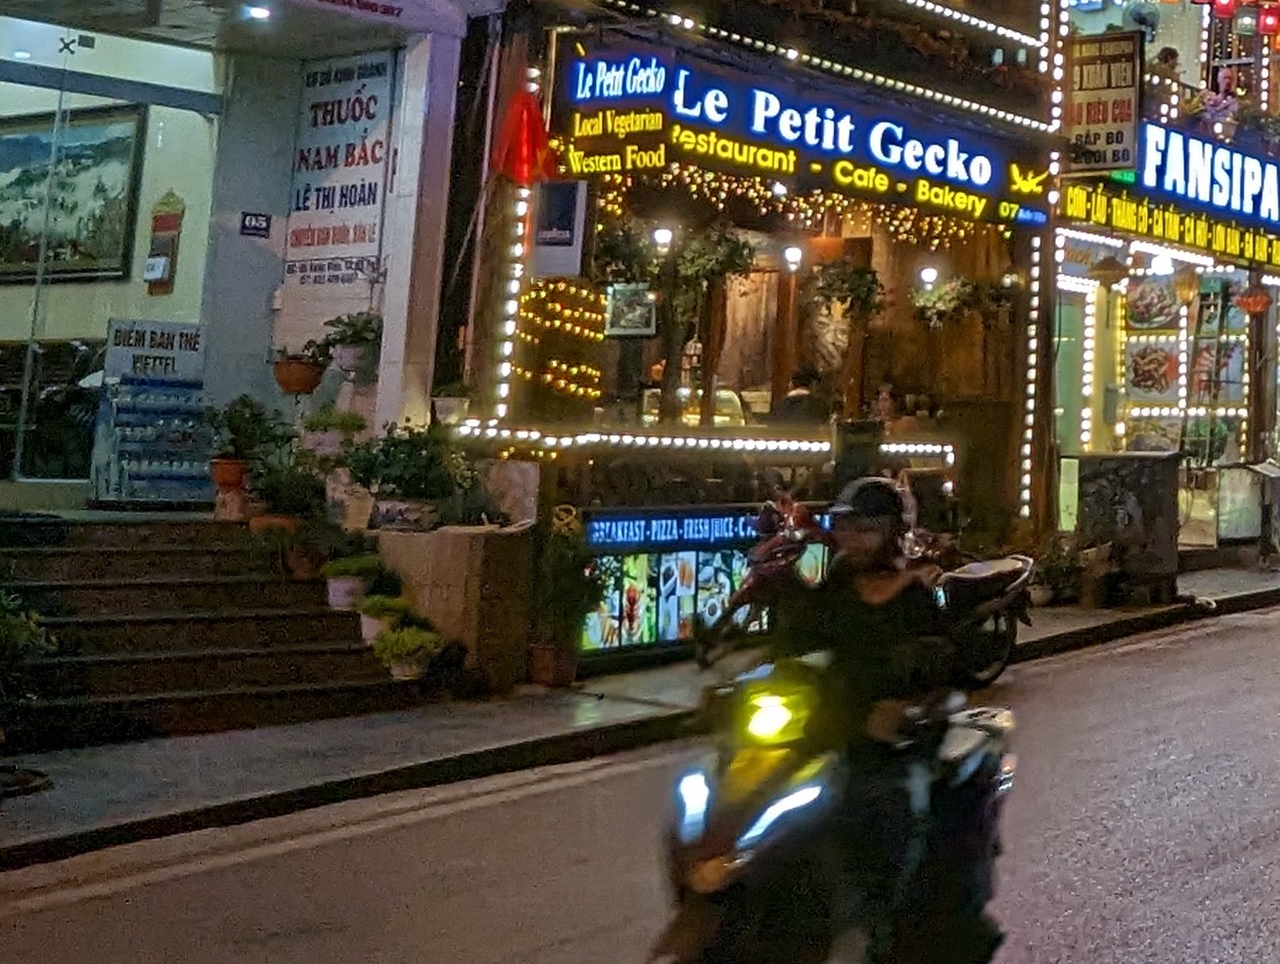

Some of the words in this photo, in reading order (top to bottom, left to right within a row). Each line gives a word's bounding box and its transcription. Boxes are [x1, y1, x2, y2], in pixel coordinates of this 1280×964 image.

[576, 62, 594, 98] Le
[595, 61, 625, 97] Petit
[626, 57, 666, 94] Gecko
[574, 111, 602, 137] Local
[606, 107, 663, 138] Vegetarian
[674, 69, 728, 122] Le
[752, 88, 855, 153] Petit
[869, 121, 991, 185] Gecko
[568, 143, 622, 174] Western
[626, 144, 666, 169] Food
[835, 160, 889, 192] Cafe
[916, 179, 987, 218] Bakery
[244, 215, 268, 228] 05
[650, 518, 679, 541] PIZZA
[683, 517, 710, 539] FRESH
[711, 515, 735, 542] JUICE
